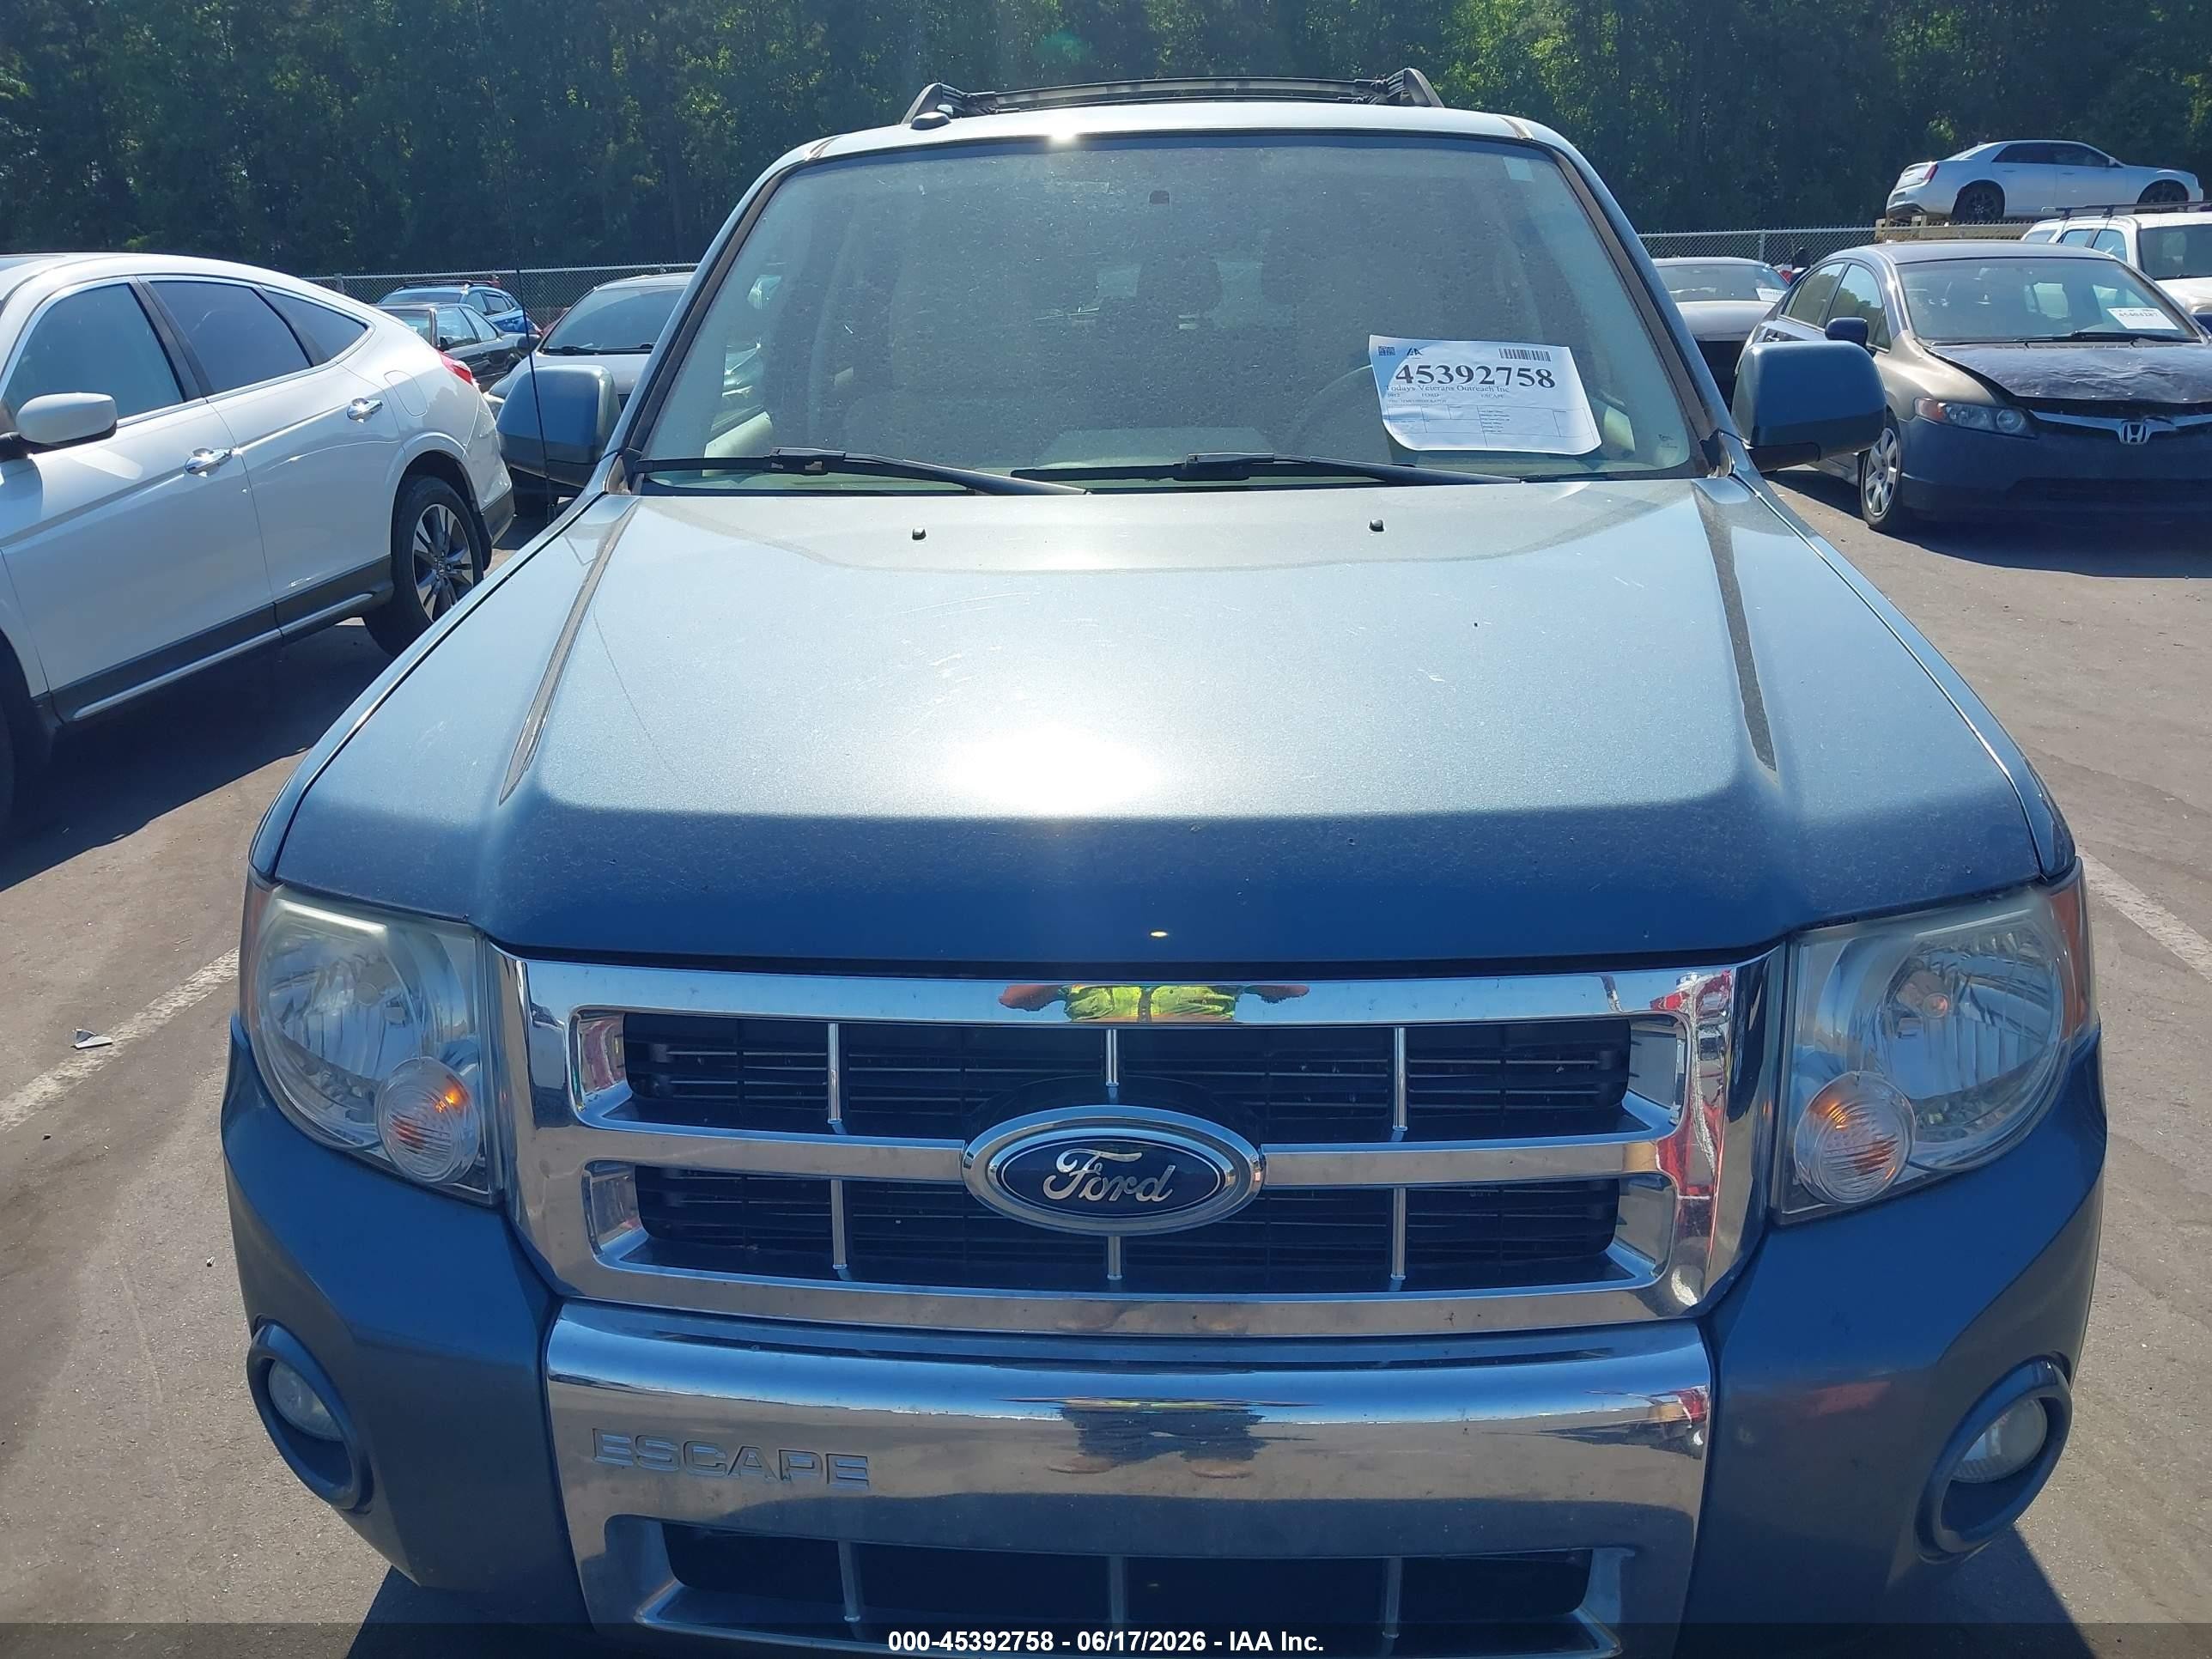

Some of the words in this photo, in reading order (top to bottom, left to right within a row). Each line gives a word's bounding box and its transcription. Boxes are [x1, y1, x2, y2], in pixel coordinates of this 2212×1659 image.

[1395, 364, 1556, 388] 45392758
[1042, 1148, 1177, 1202] Ford
[592, 1428, 870, 1489] ESCAPE
